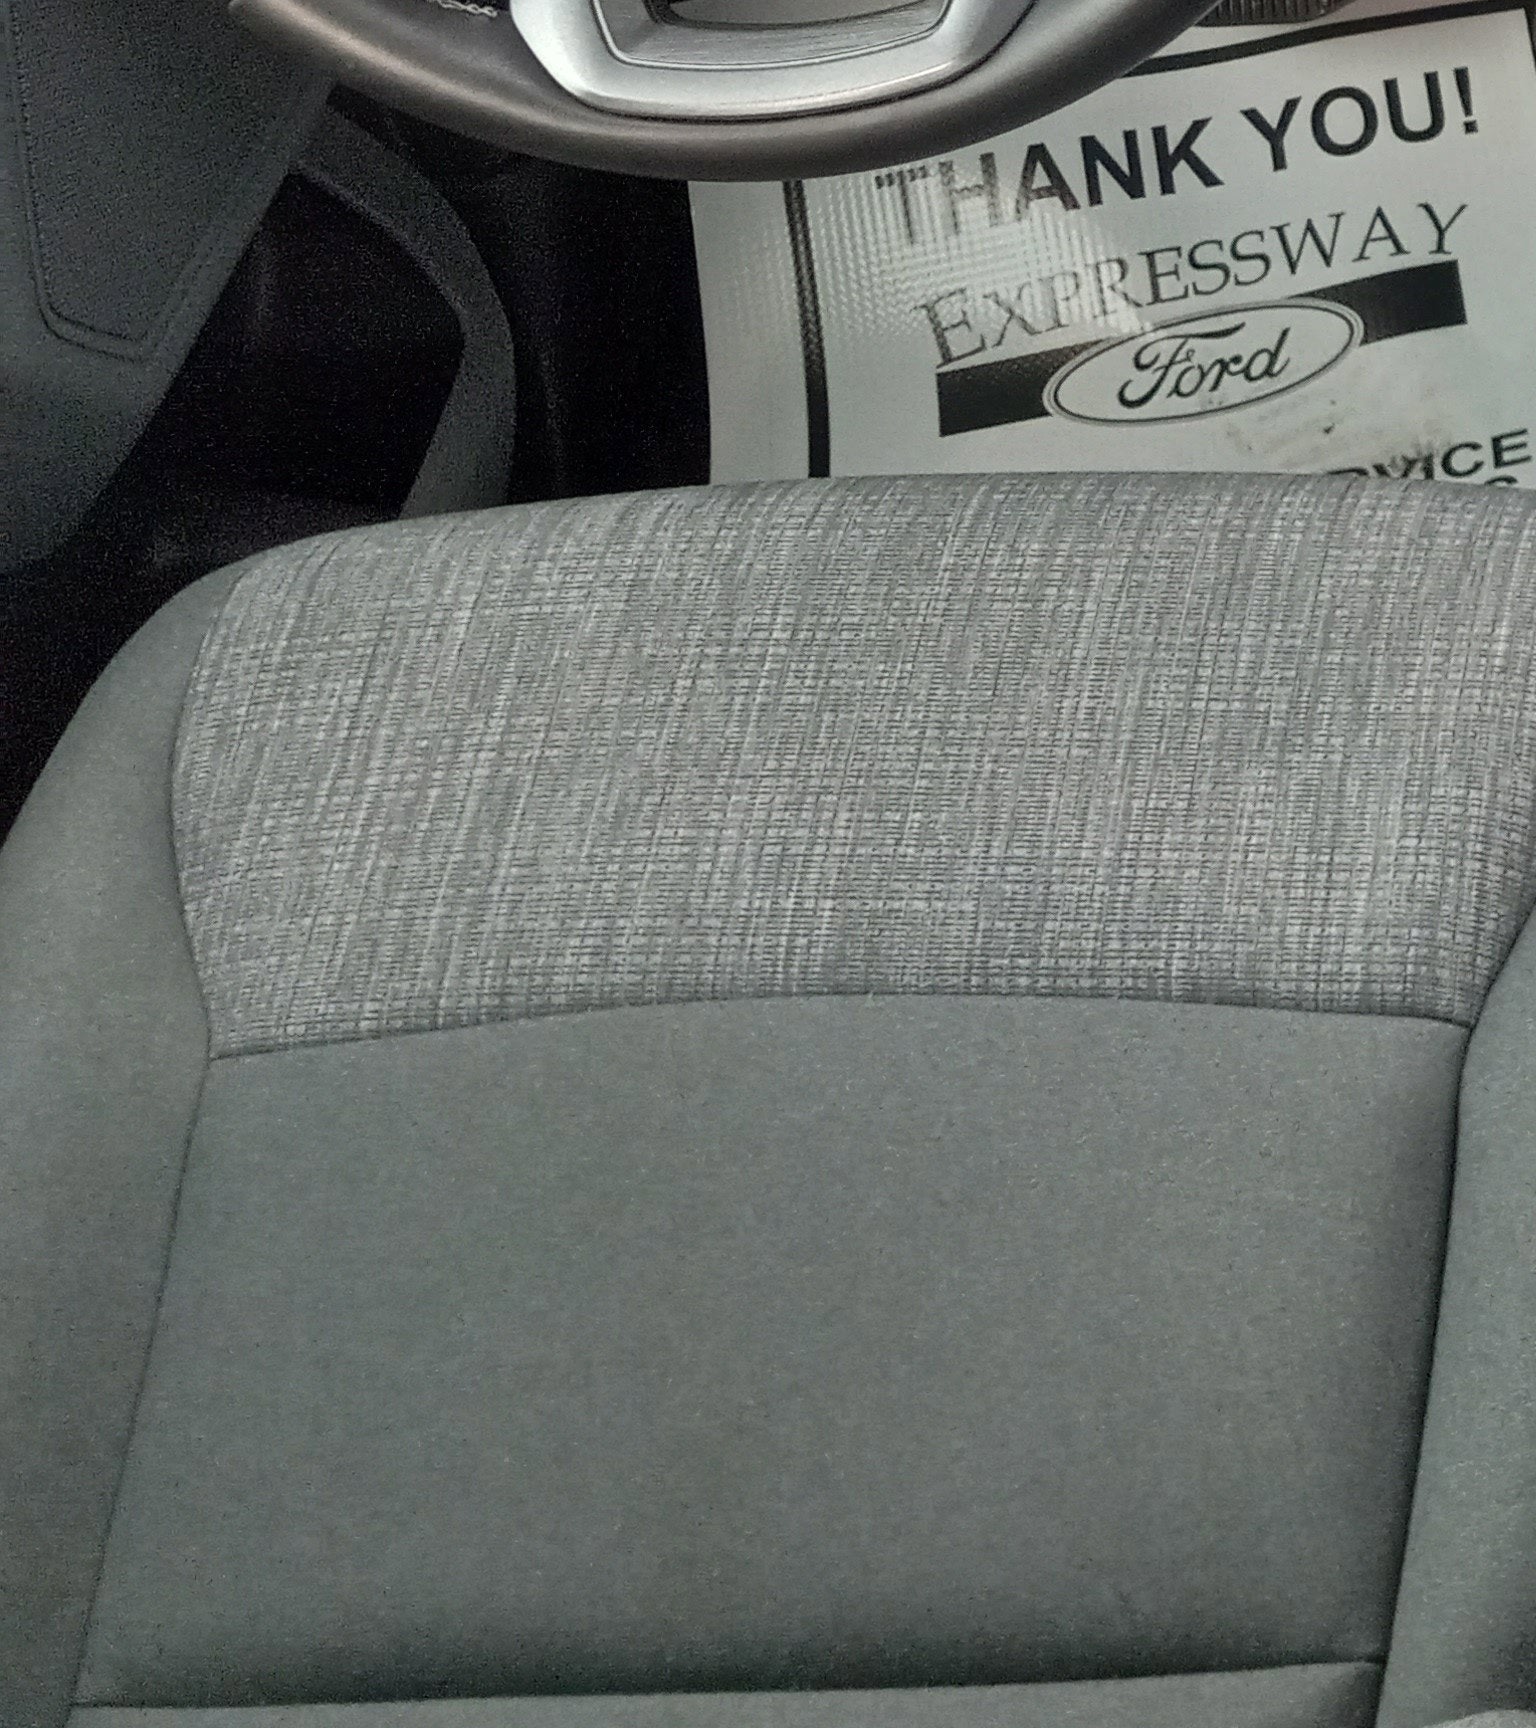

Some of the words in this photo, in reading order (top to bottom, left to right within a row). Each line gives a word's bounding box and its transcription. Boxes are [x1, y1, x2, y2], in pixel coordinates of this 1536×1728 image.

[875, 119, 1224, 247] THANK
[1240, 66, 1481, 175] YOU!
[914, 203, 1468, 366] EXPRESSWAY
[1116, 321, 1293, 411] Ford
